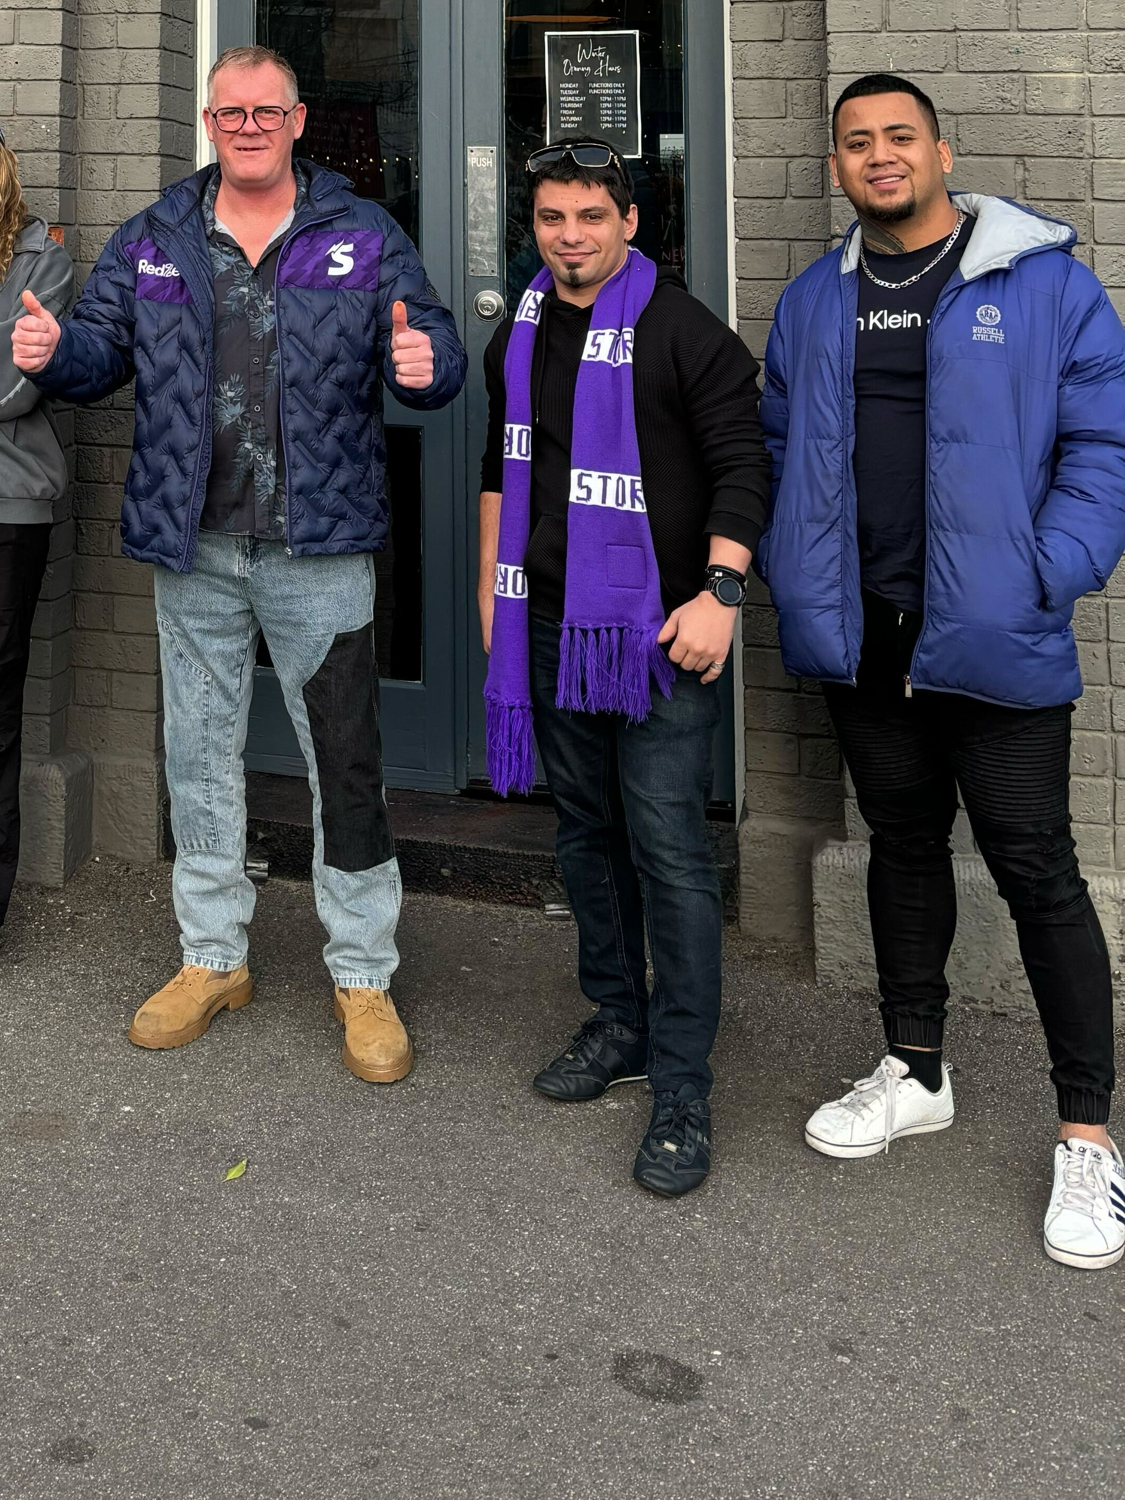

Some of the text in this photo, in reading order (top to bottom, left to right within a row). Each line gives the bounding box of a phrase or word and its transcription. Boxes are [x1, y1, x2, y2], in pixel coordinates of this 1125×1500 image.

[578, 38, 606, 63] Winter
[563, 55, 622, 77] Opening Hours
[471, 157, 493, 168] PUSH
[868, 309, 922, 331] Klein
[972, 326, 1005, 337] RUSSELL
[972, 333, 1005, 344] ATHLETIC
[575, 471, 645, 510] STOR
